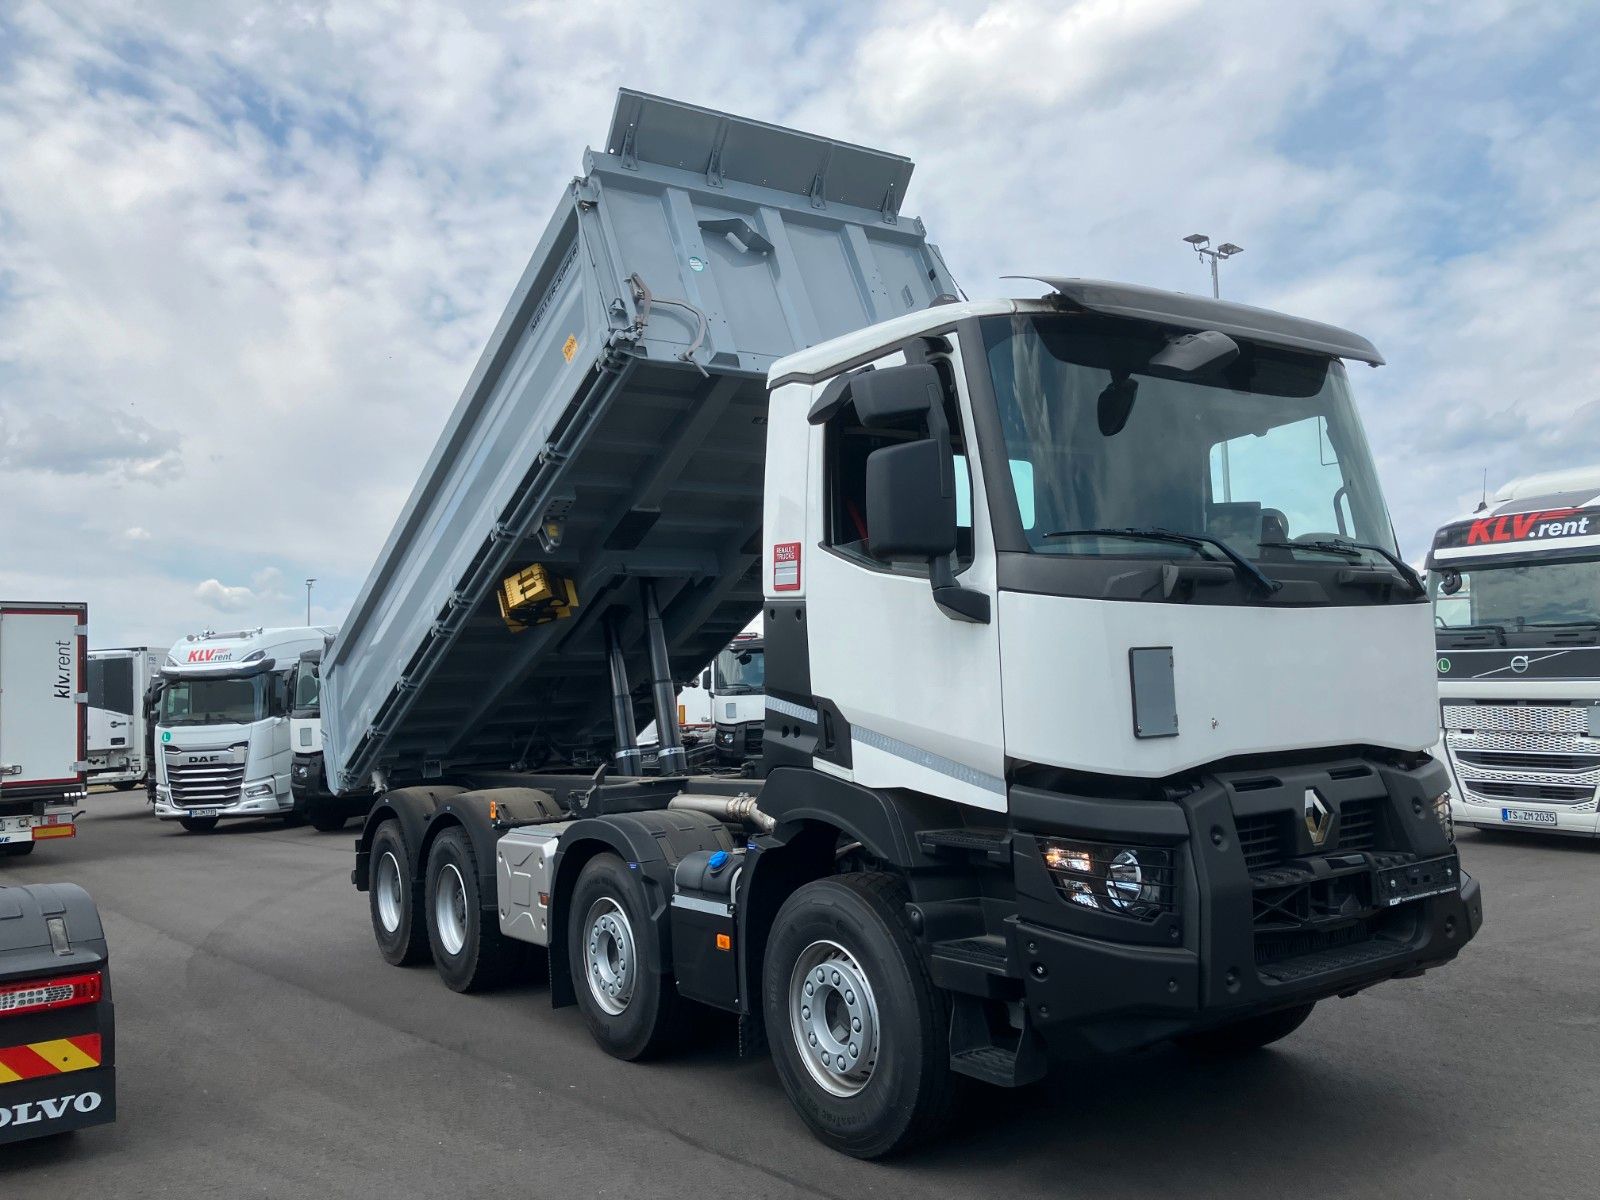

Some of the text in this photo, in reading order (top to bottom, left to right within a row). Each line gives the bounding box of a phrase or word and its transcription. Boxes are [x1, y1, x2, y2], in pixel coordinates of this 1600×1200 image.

[1467, 512, 1590, 544] KLV.rent
[187, 648, 232, 662] KLV.rent
[54, 639, 71, 699] klv.rent
[188, 755, 220, 763] DAF
